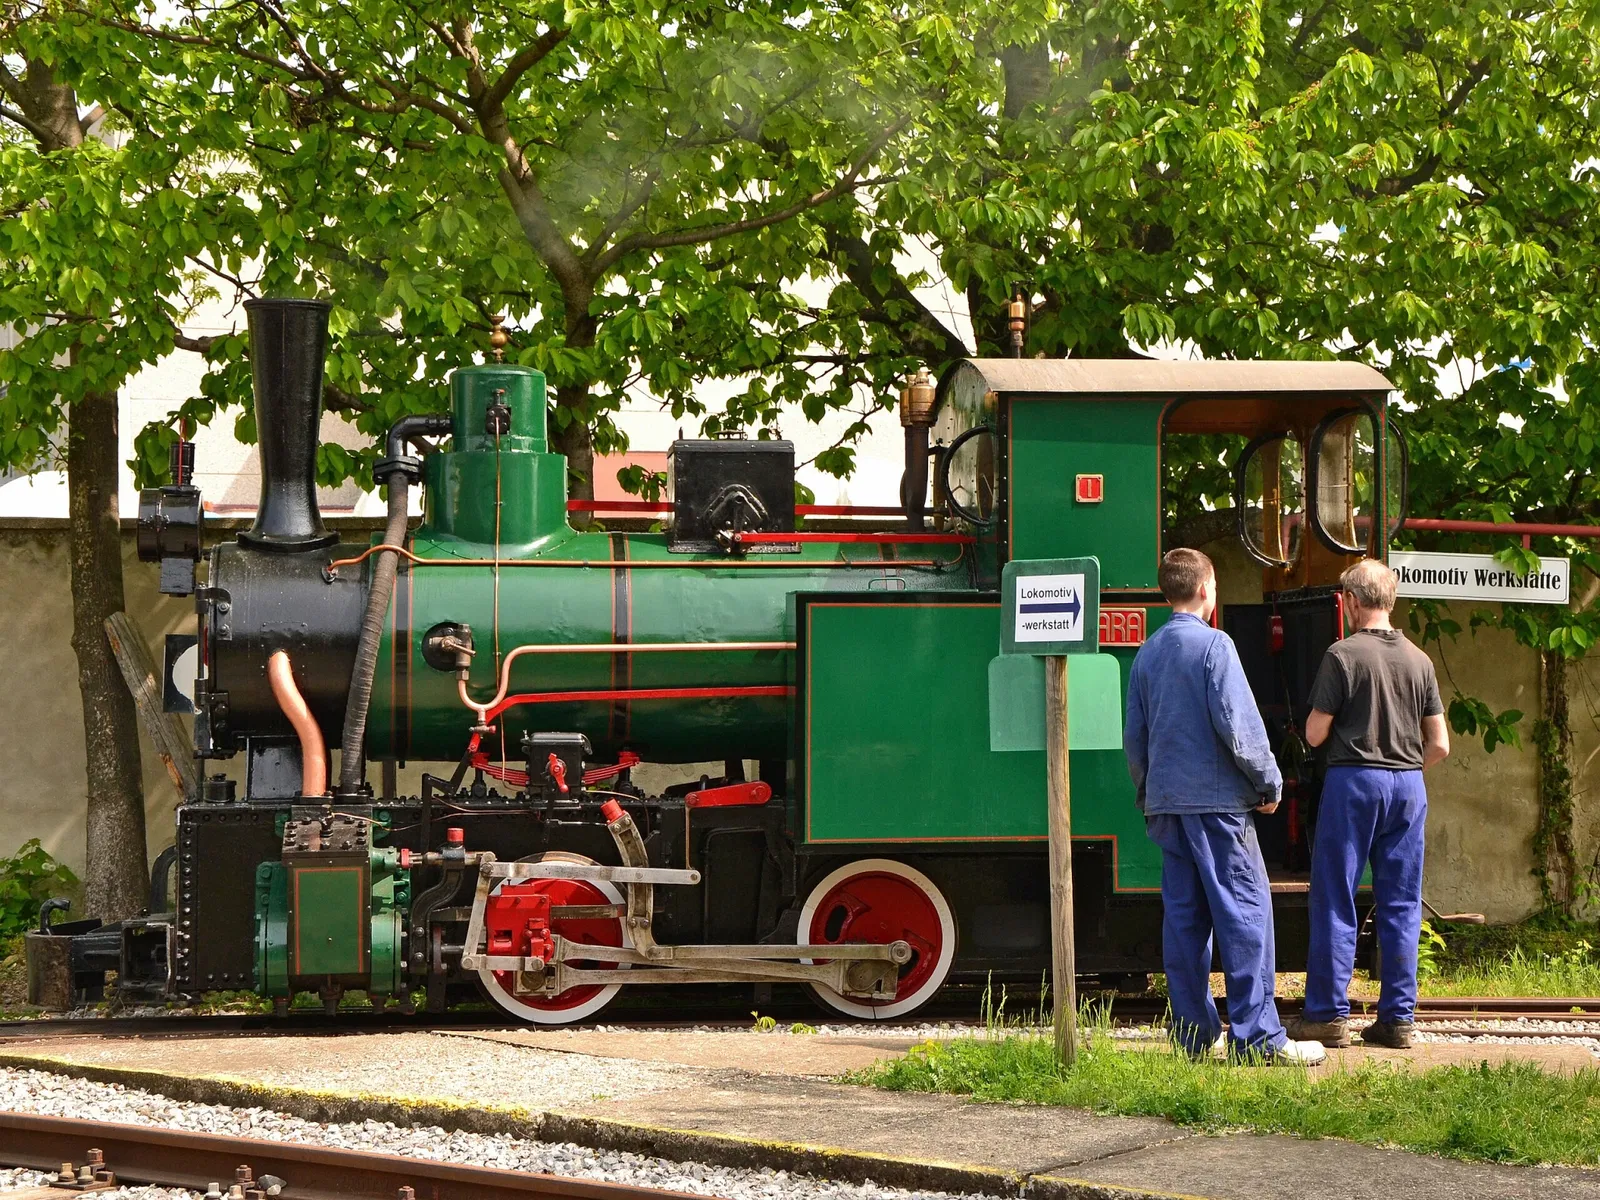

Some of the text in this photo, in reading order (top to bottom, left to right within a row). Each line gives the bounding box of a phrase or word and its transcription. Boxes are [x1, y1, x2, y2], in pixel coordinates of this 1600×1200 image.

[1392, 565, 1468, 586] okomotiv
[1021, 587, 1072, 599] Lokomotiv
[1021, 619, 1070, 630] -werkstatt
